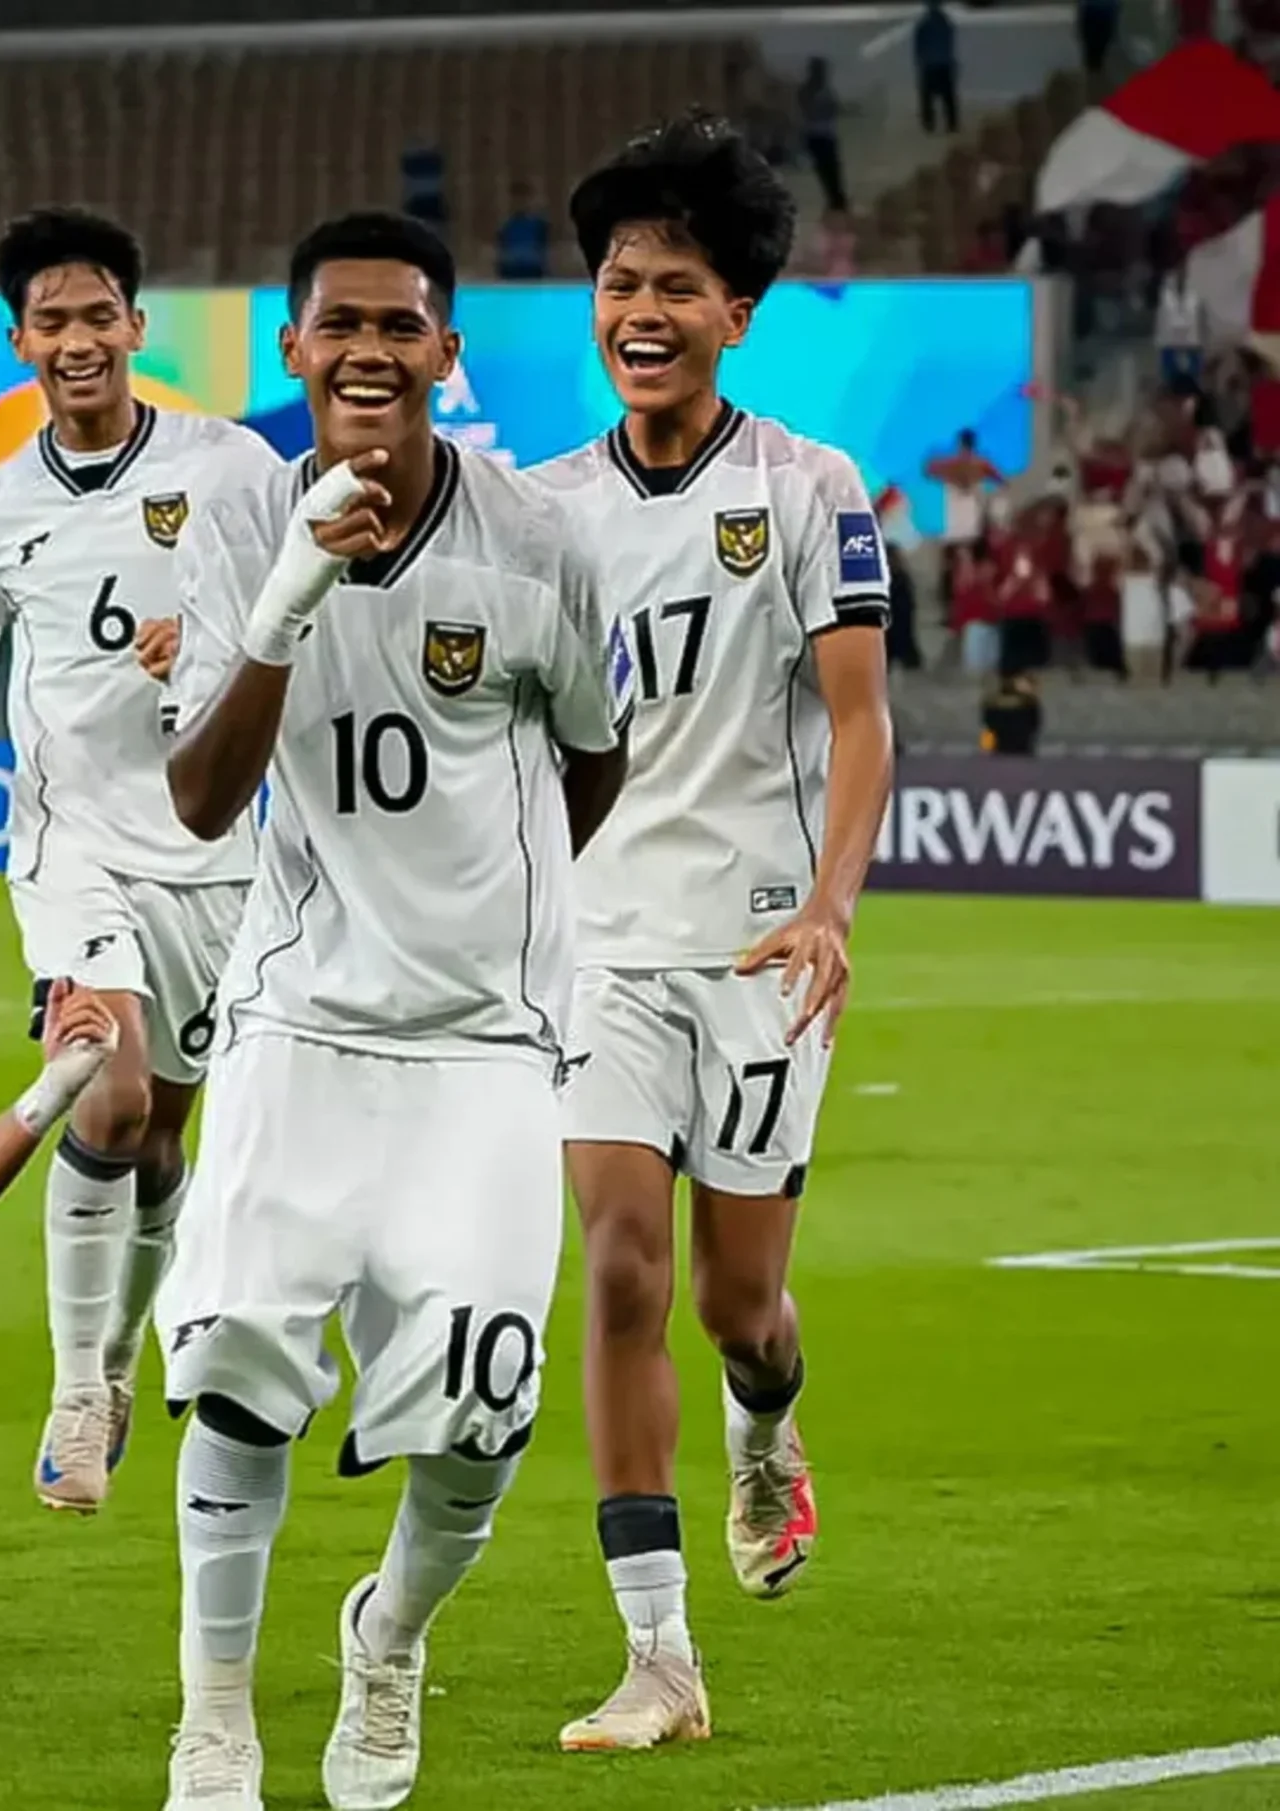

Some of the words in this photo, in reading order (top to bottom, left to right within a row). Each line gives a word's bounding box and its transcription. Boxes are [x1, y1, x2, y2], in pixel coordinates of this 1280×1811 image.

[88, 574, 136, 652] 6
[631, 595, 714, 700] 17
[331, 709, 429, 815] 10
[716, 1057, 791, 1154] 17
[443, 1305, 536, 1412] 10
